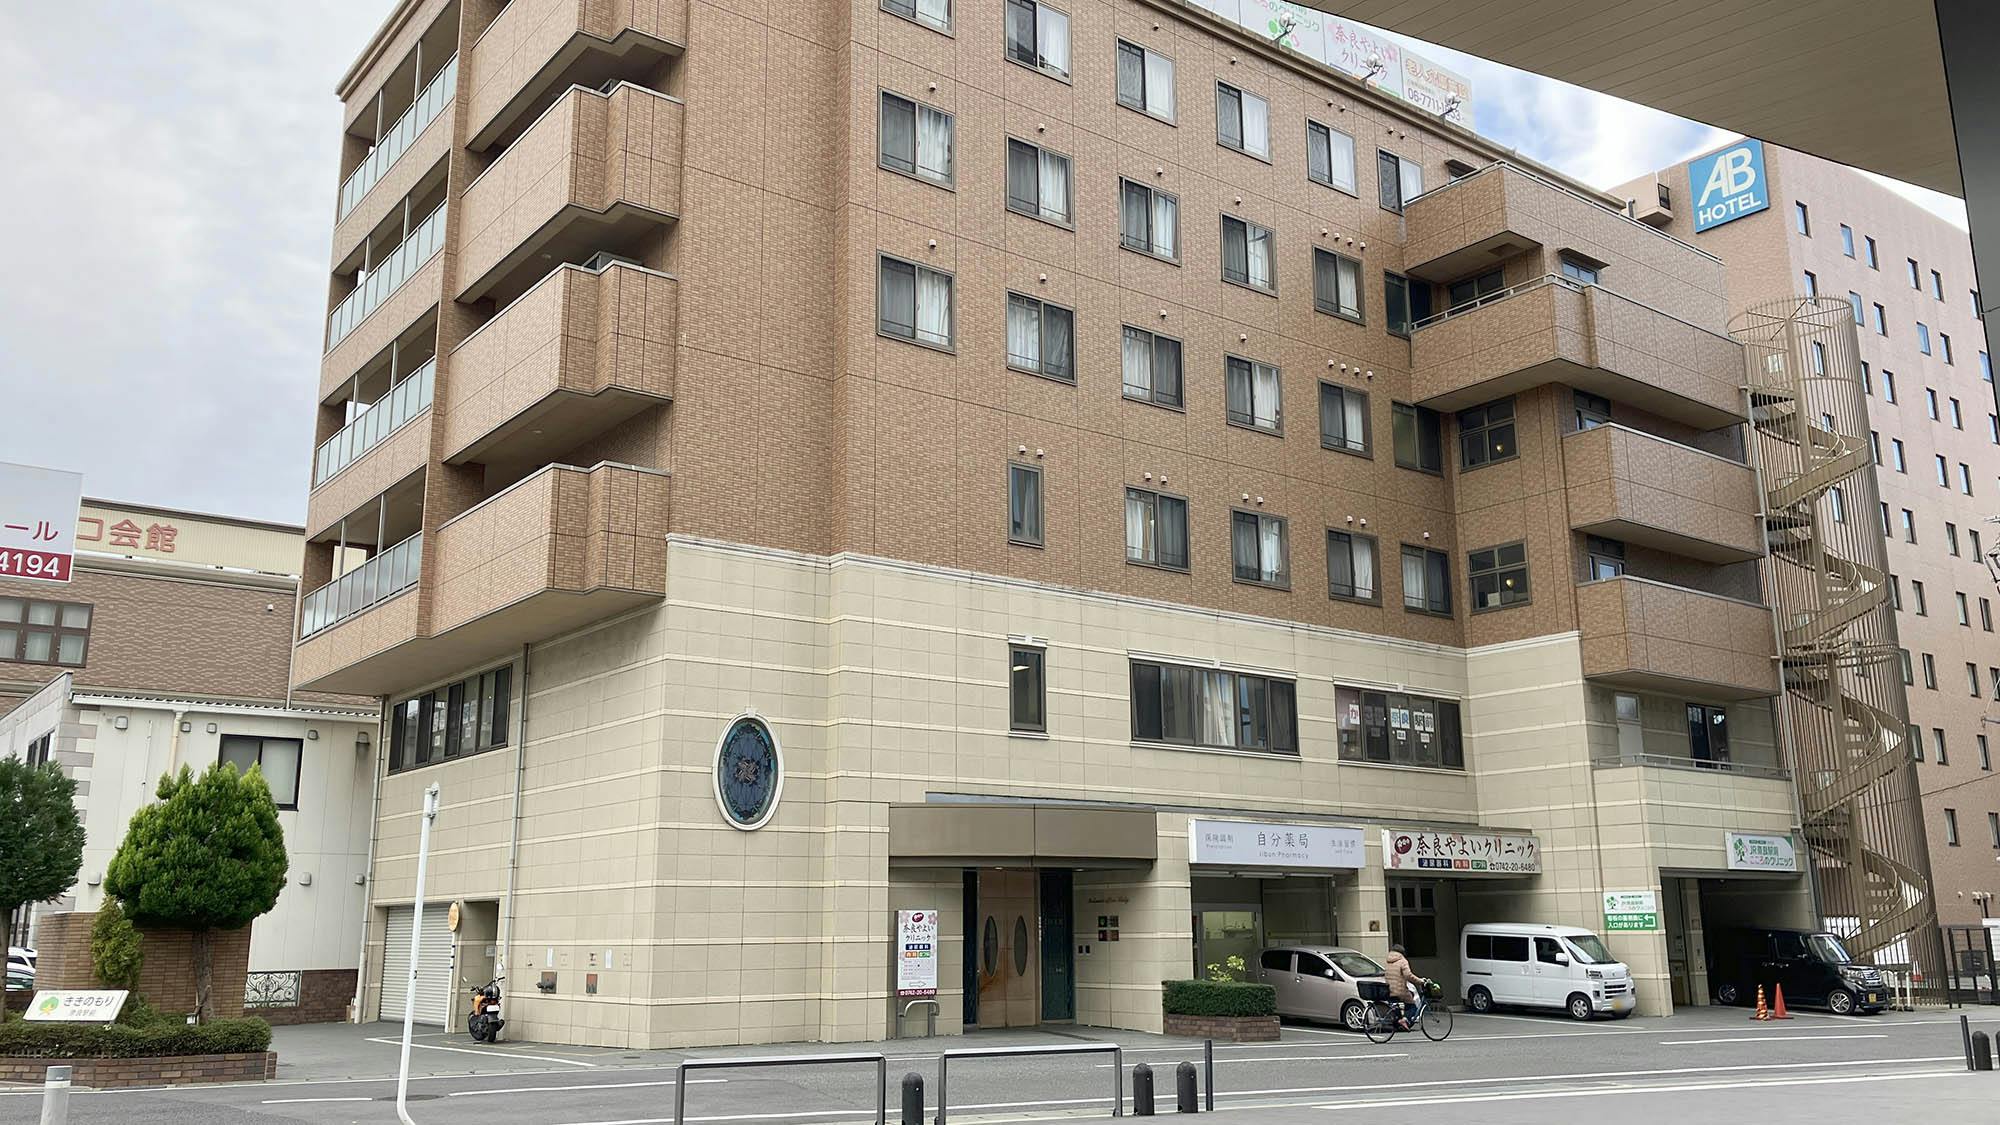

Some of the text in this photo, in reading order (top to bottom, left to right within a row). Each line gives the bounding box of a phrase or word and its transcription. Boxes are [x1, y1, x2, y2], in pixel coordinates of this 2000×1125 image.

[1698, 147, 1756, 207] AB
[1698, 191, 1762, 225] HOTEL
[4, 520, 58, 541] ール
[1257, 831, 1310, 849] 自分薬局
[1416, 833, 1535, 858] 奈良やよいクリニック
[1496, 862, 1536, 872] 0742-20-6480
[1749, 856, 1794, 867] こころのクリニック
[903, 923, 934, 933] 奈良やよい
[905, 934, 931, 943] クリニック
